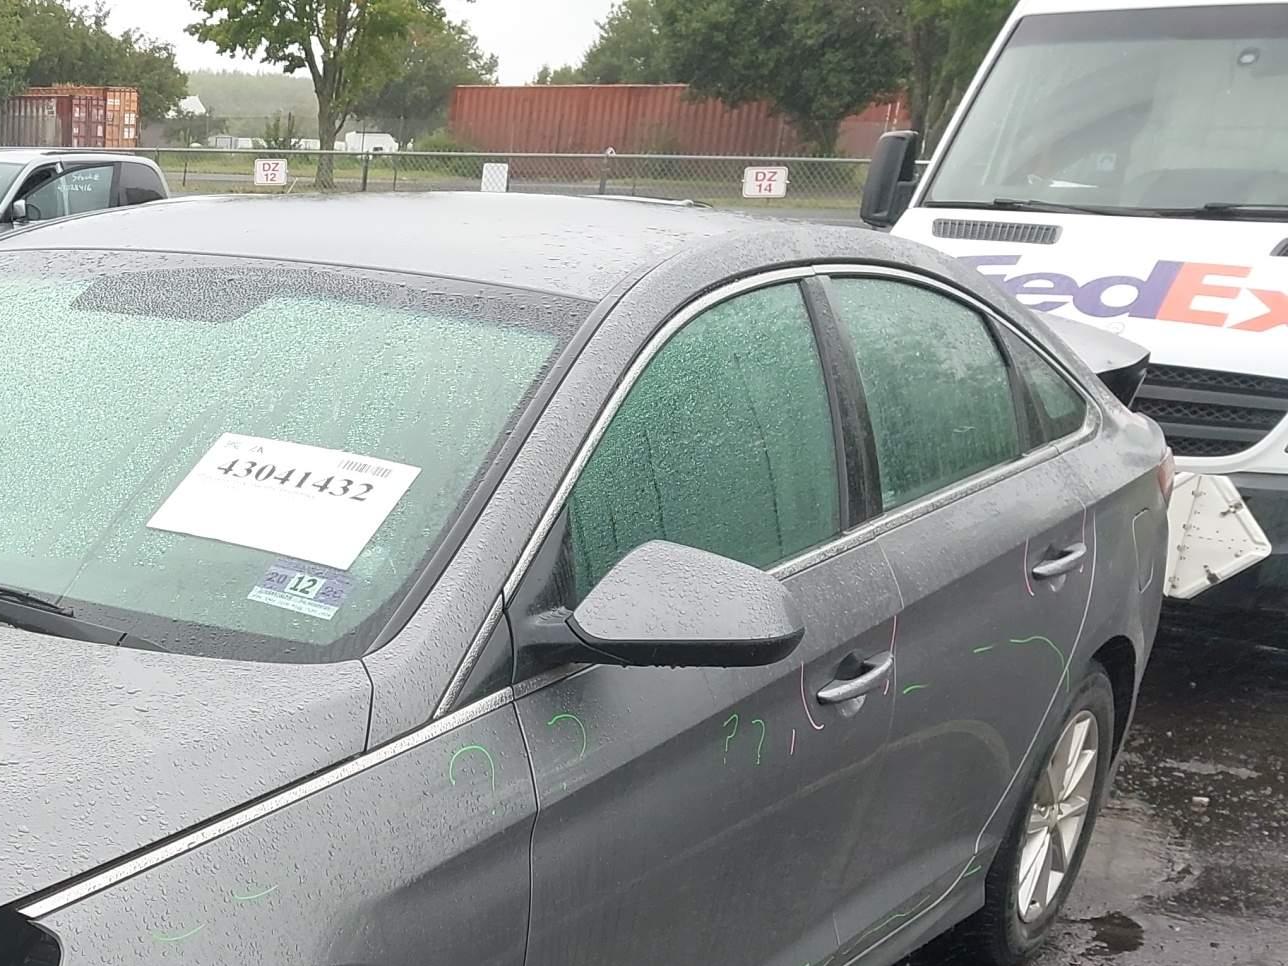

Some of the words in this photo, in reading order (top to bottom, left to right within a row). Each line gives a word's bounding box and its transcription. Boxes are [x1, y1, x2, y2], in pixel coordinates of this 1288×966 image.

[262, 162, 280, 172] DZ
[264, 173, 277, 182] 12
[755, 171, 778, 182] DZ
[756, 183, 772, 193] 14
[217, 458, 374, 501] 43041432
[289, 575, 318, 595] 12
